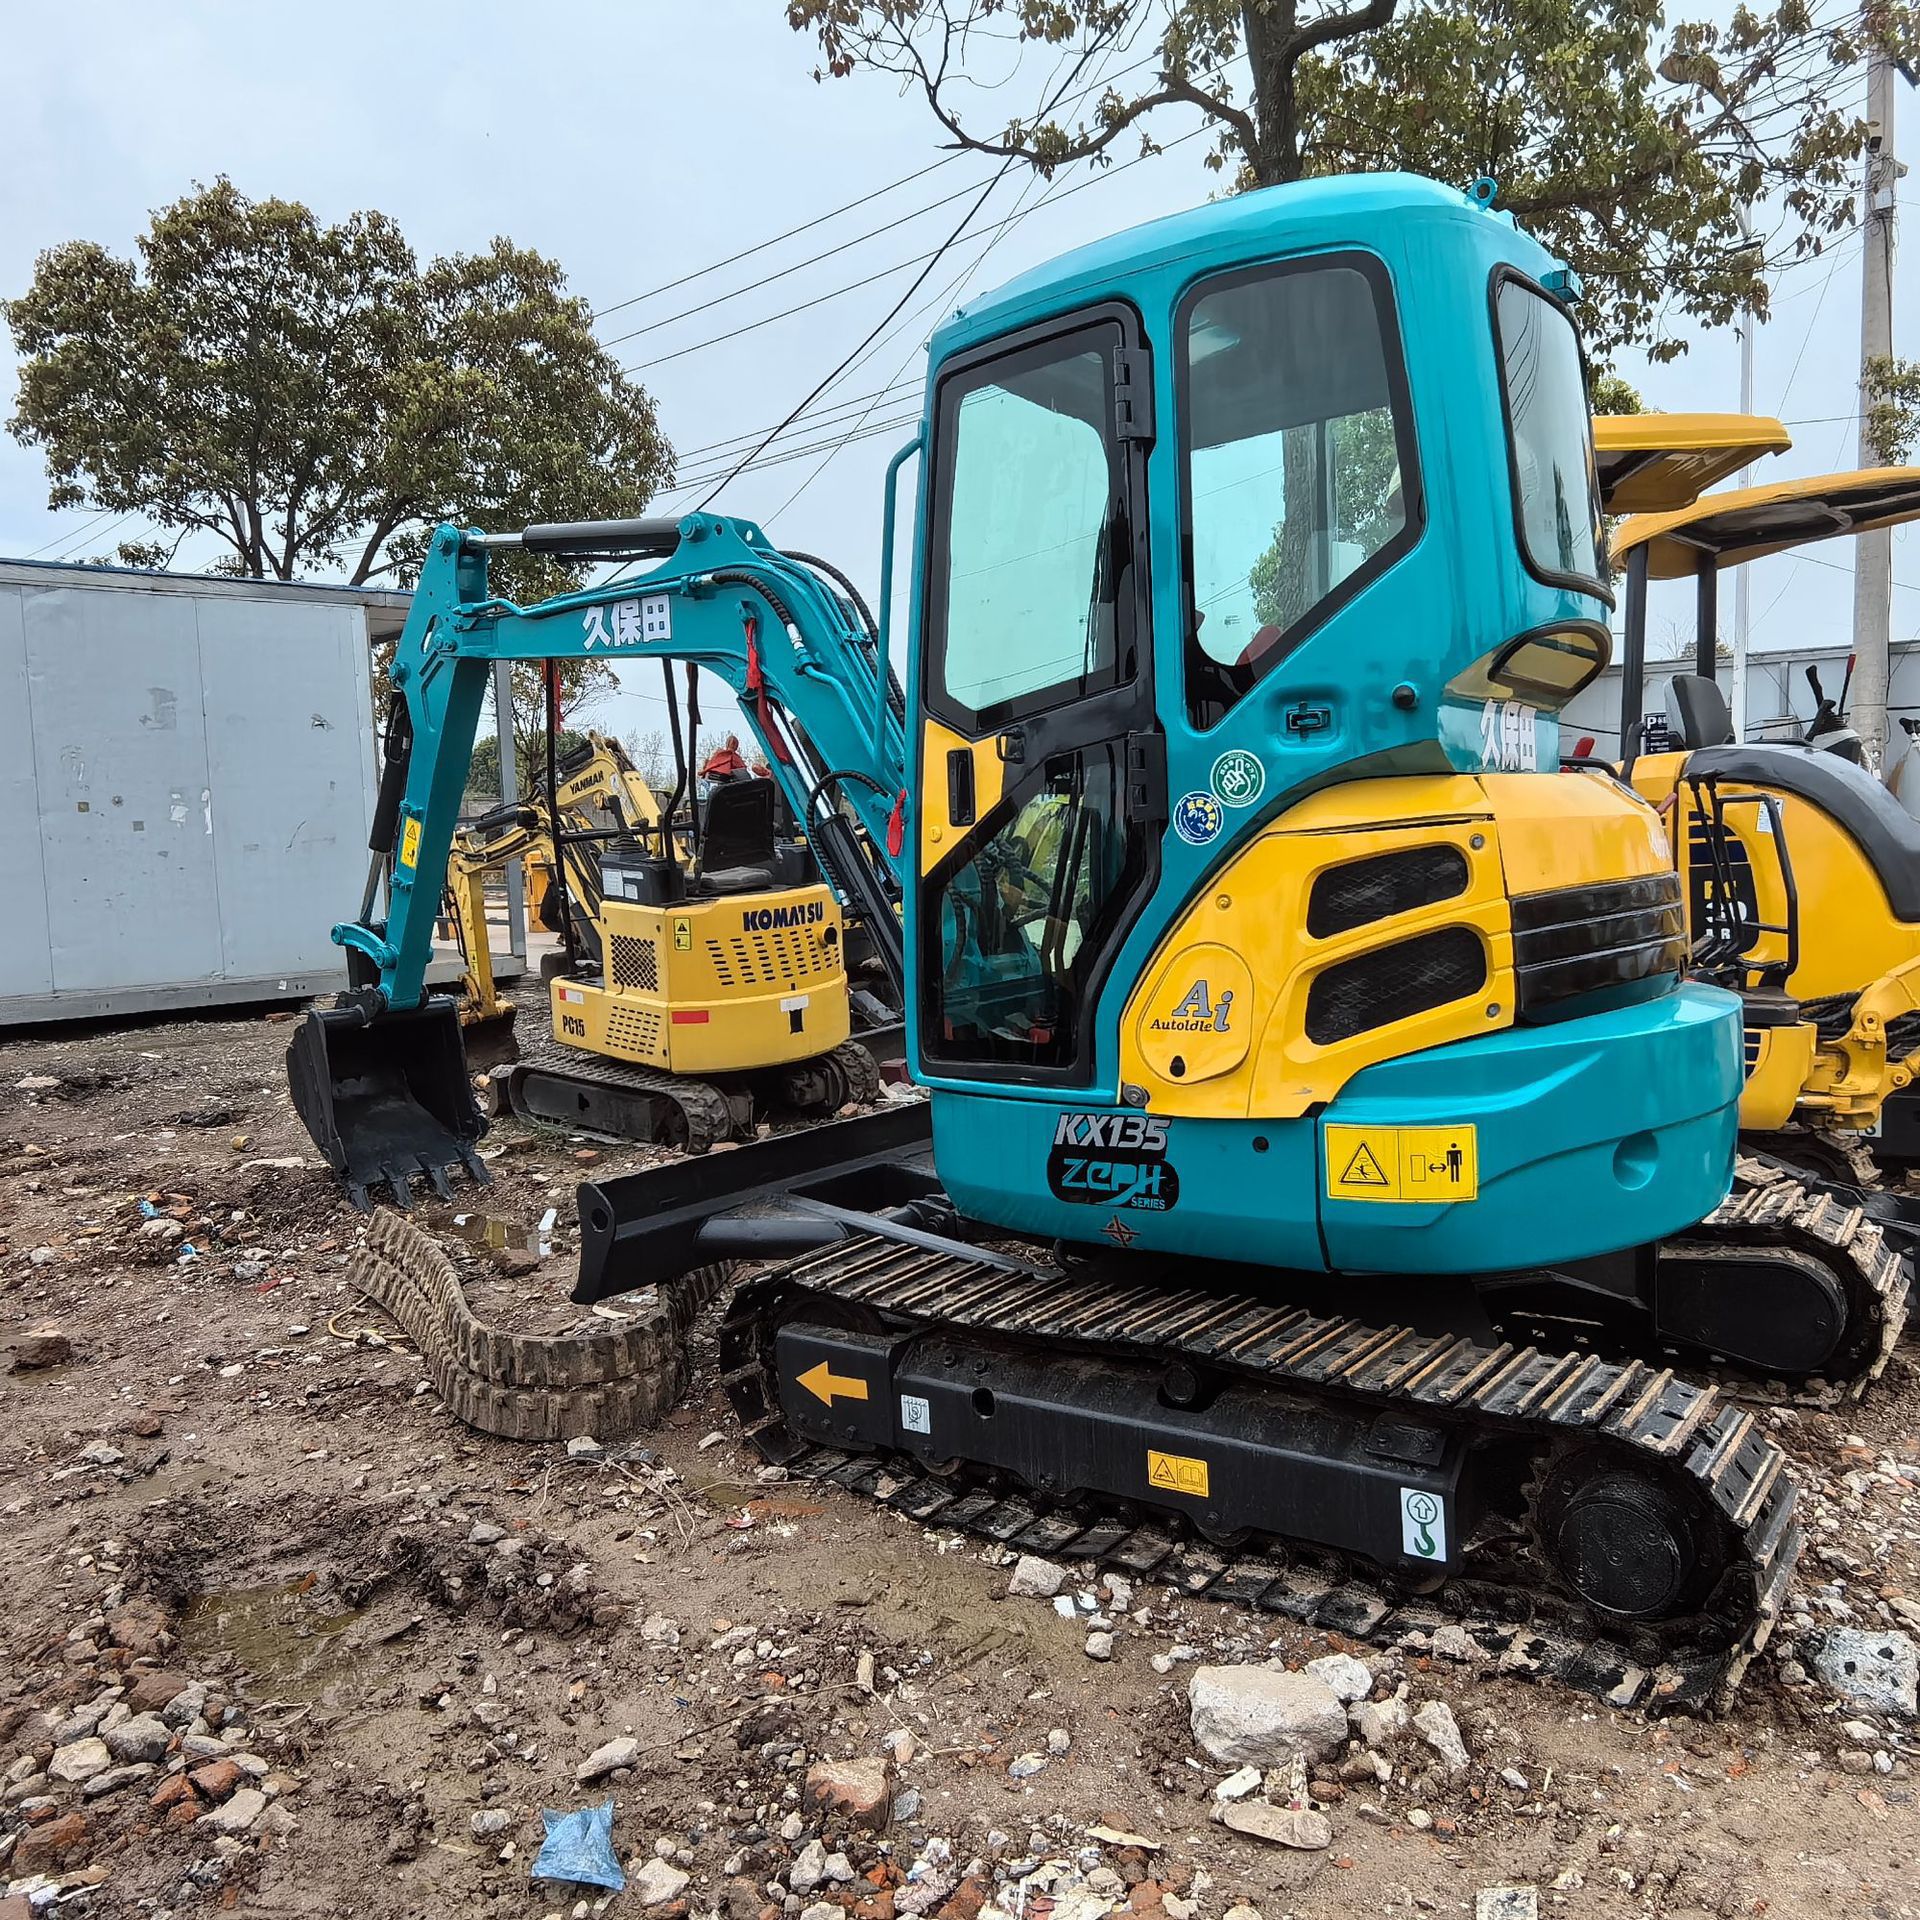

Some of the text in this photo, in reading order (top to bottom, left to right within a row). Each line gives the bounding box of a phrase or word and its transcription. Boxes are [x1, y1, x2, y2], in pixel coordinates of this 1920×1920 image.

[582, 594, 672, 651] 久保田
[1480, 698, 1538, 772] 久保田
[742, 901, 824, 932] KOMATSU
[1171, 979, 1234, 1033] Ai
[562, 1014, 586, 1038] PC15
[1053, 1114, 1171, 1151] KX135
[1130, 1197, 1166, 1210] SERIES
